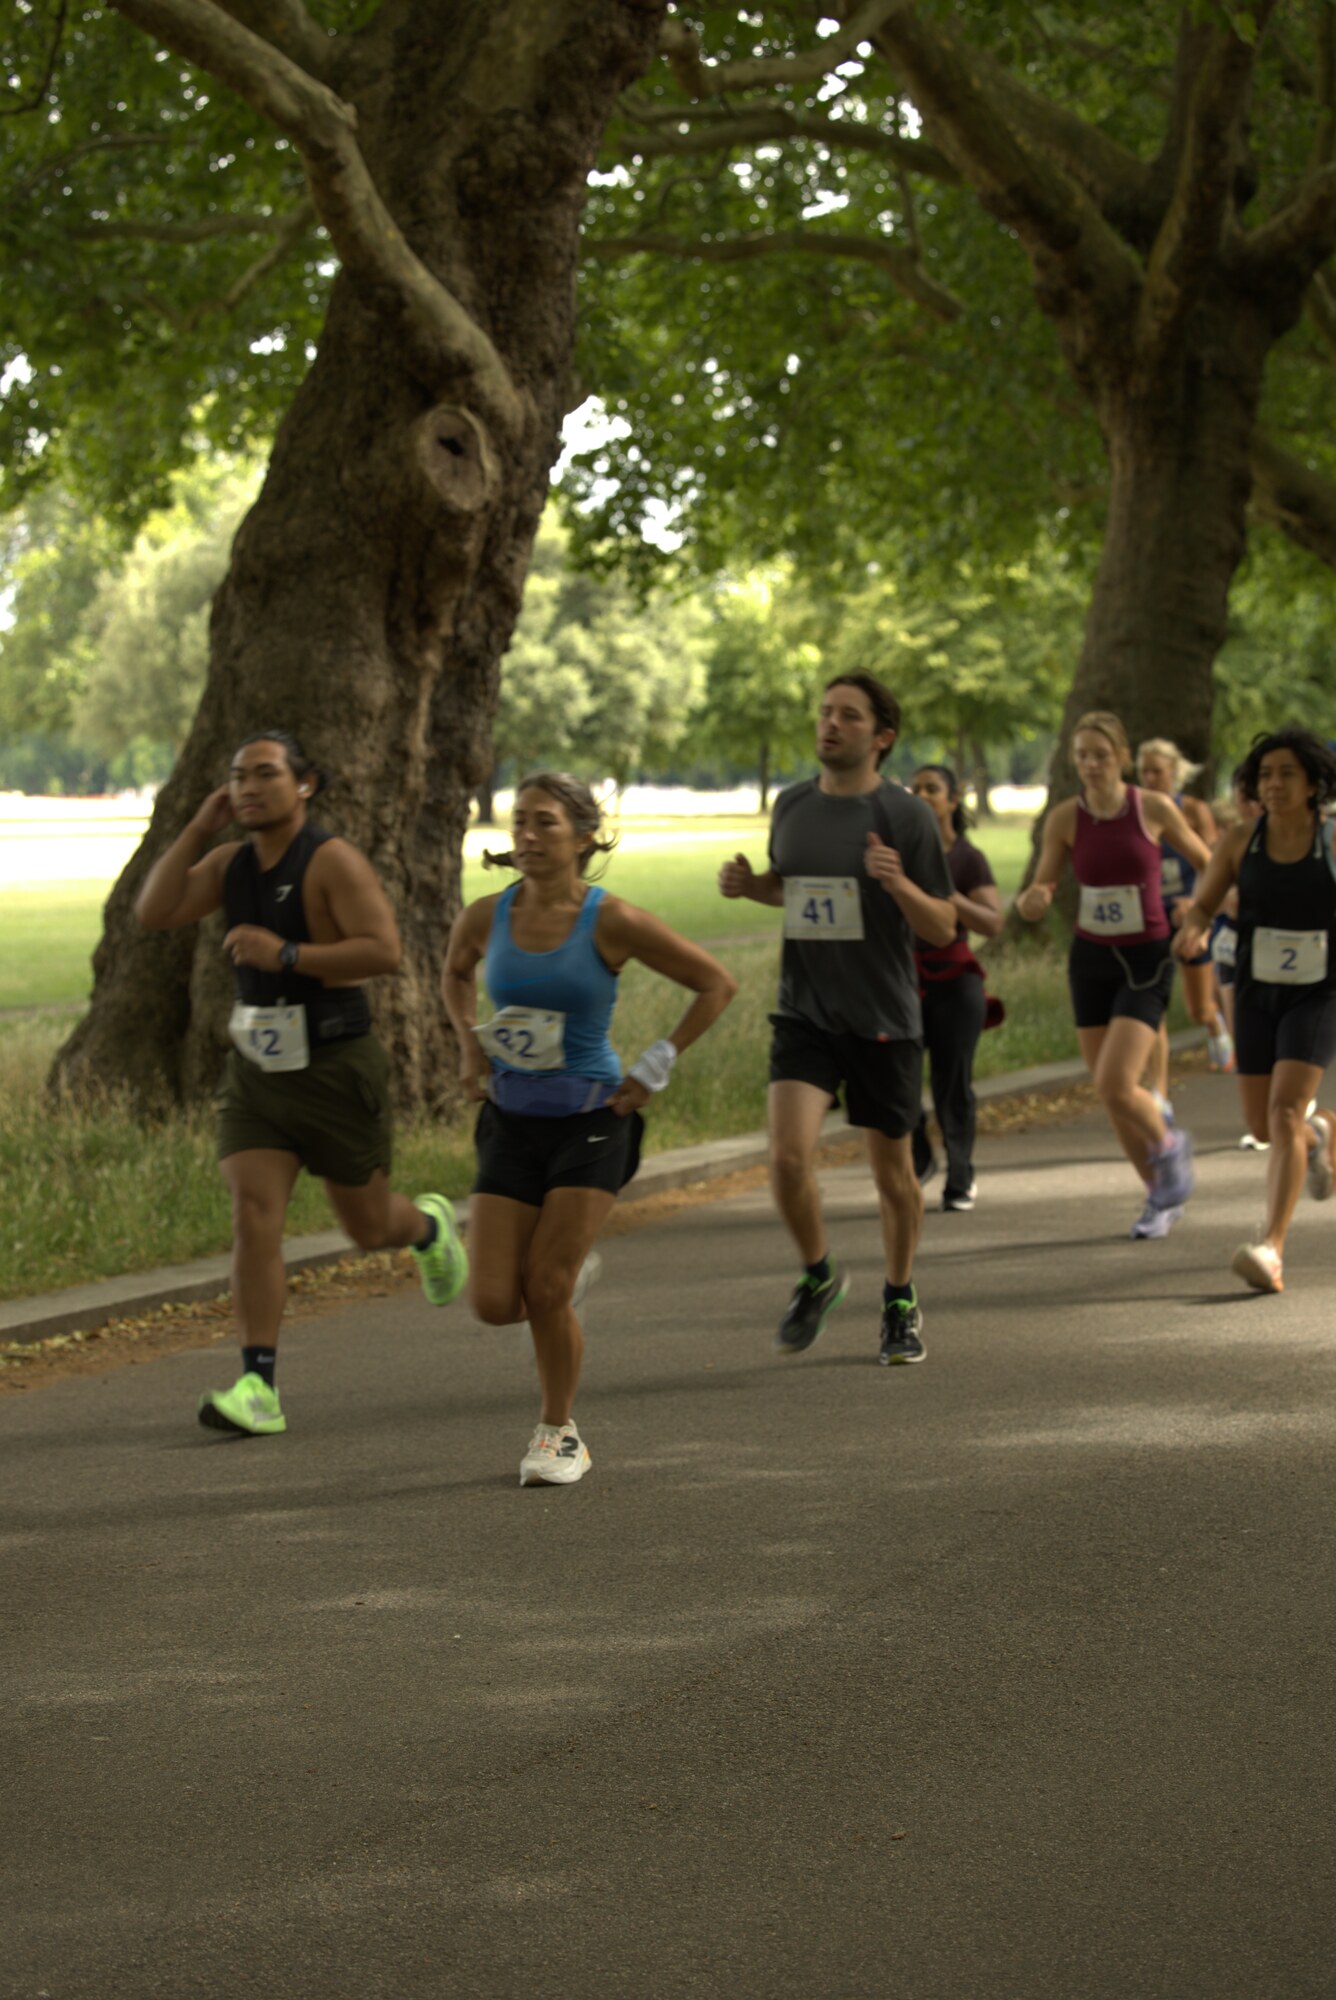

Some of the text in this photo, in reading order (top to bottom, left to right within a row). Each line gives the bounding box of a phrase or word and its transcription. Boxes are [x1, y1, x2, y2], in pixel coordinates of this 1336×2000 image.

[803, 897, 835, 924] 41
[1093, 902, 1123, 923] 48
[1280, 948, 1297, 970] 2
